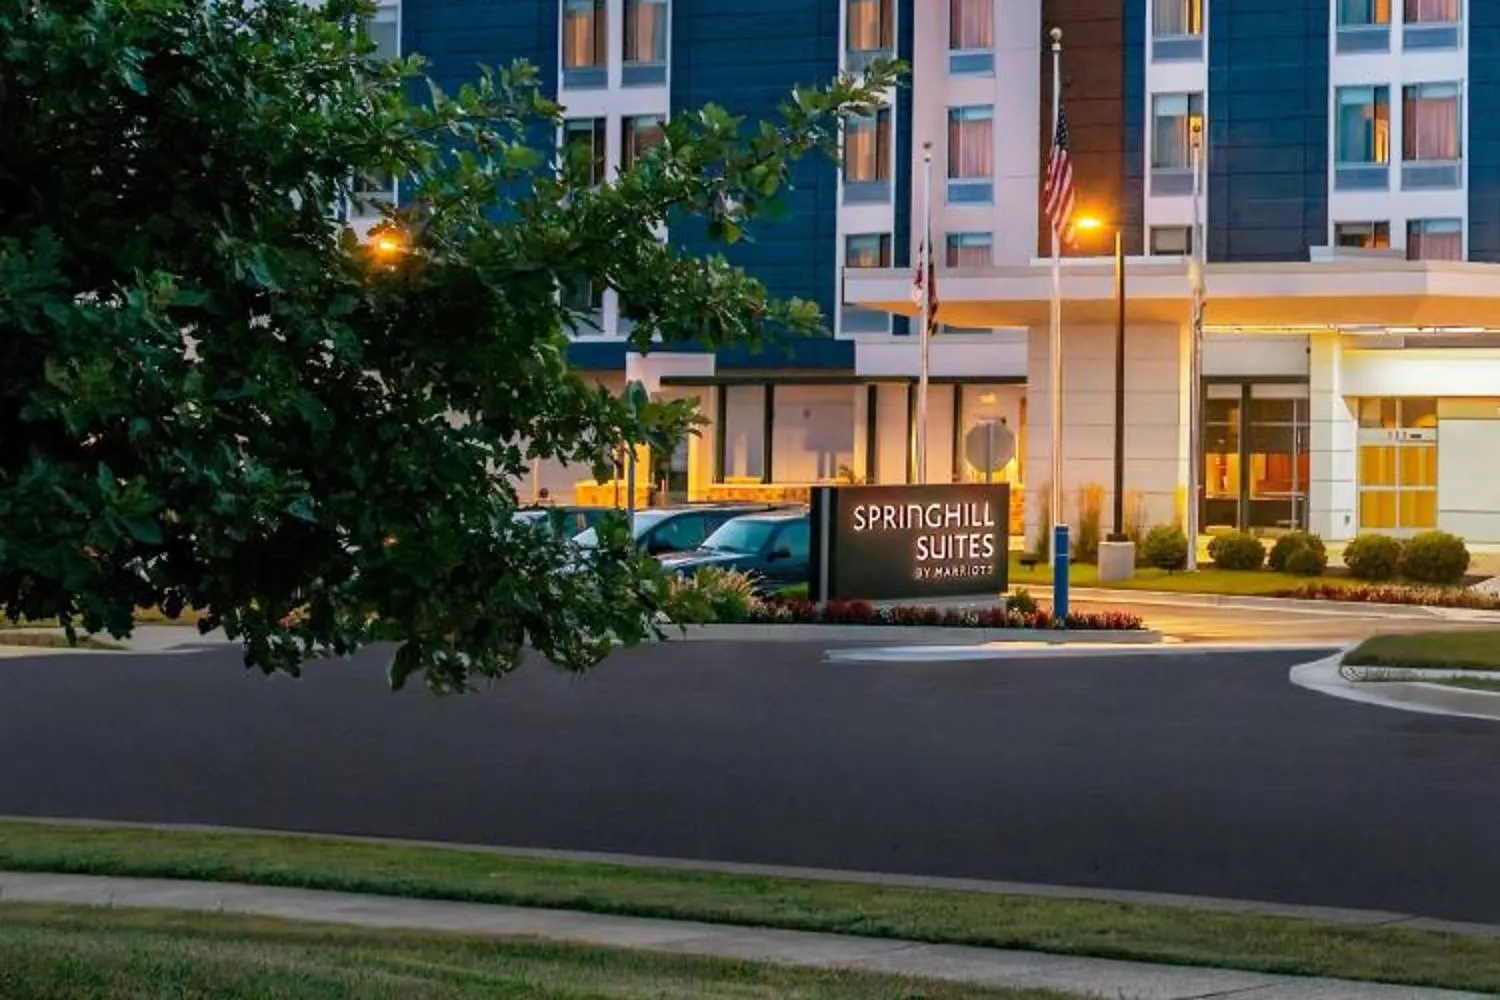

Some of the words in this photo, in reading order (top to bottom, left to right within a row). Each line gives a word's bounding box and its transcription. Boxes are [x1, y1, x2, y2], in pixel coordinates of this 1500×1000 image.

[852, 501, 995, 531] SPRINGHILL
[915, 533, 994, 561] SUITES
[914, 567, 931, 579] BY
[934, 564, 993, 578] MARRIOTT
